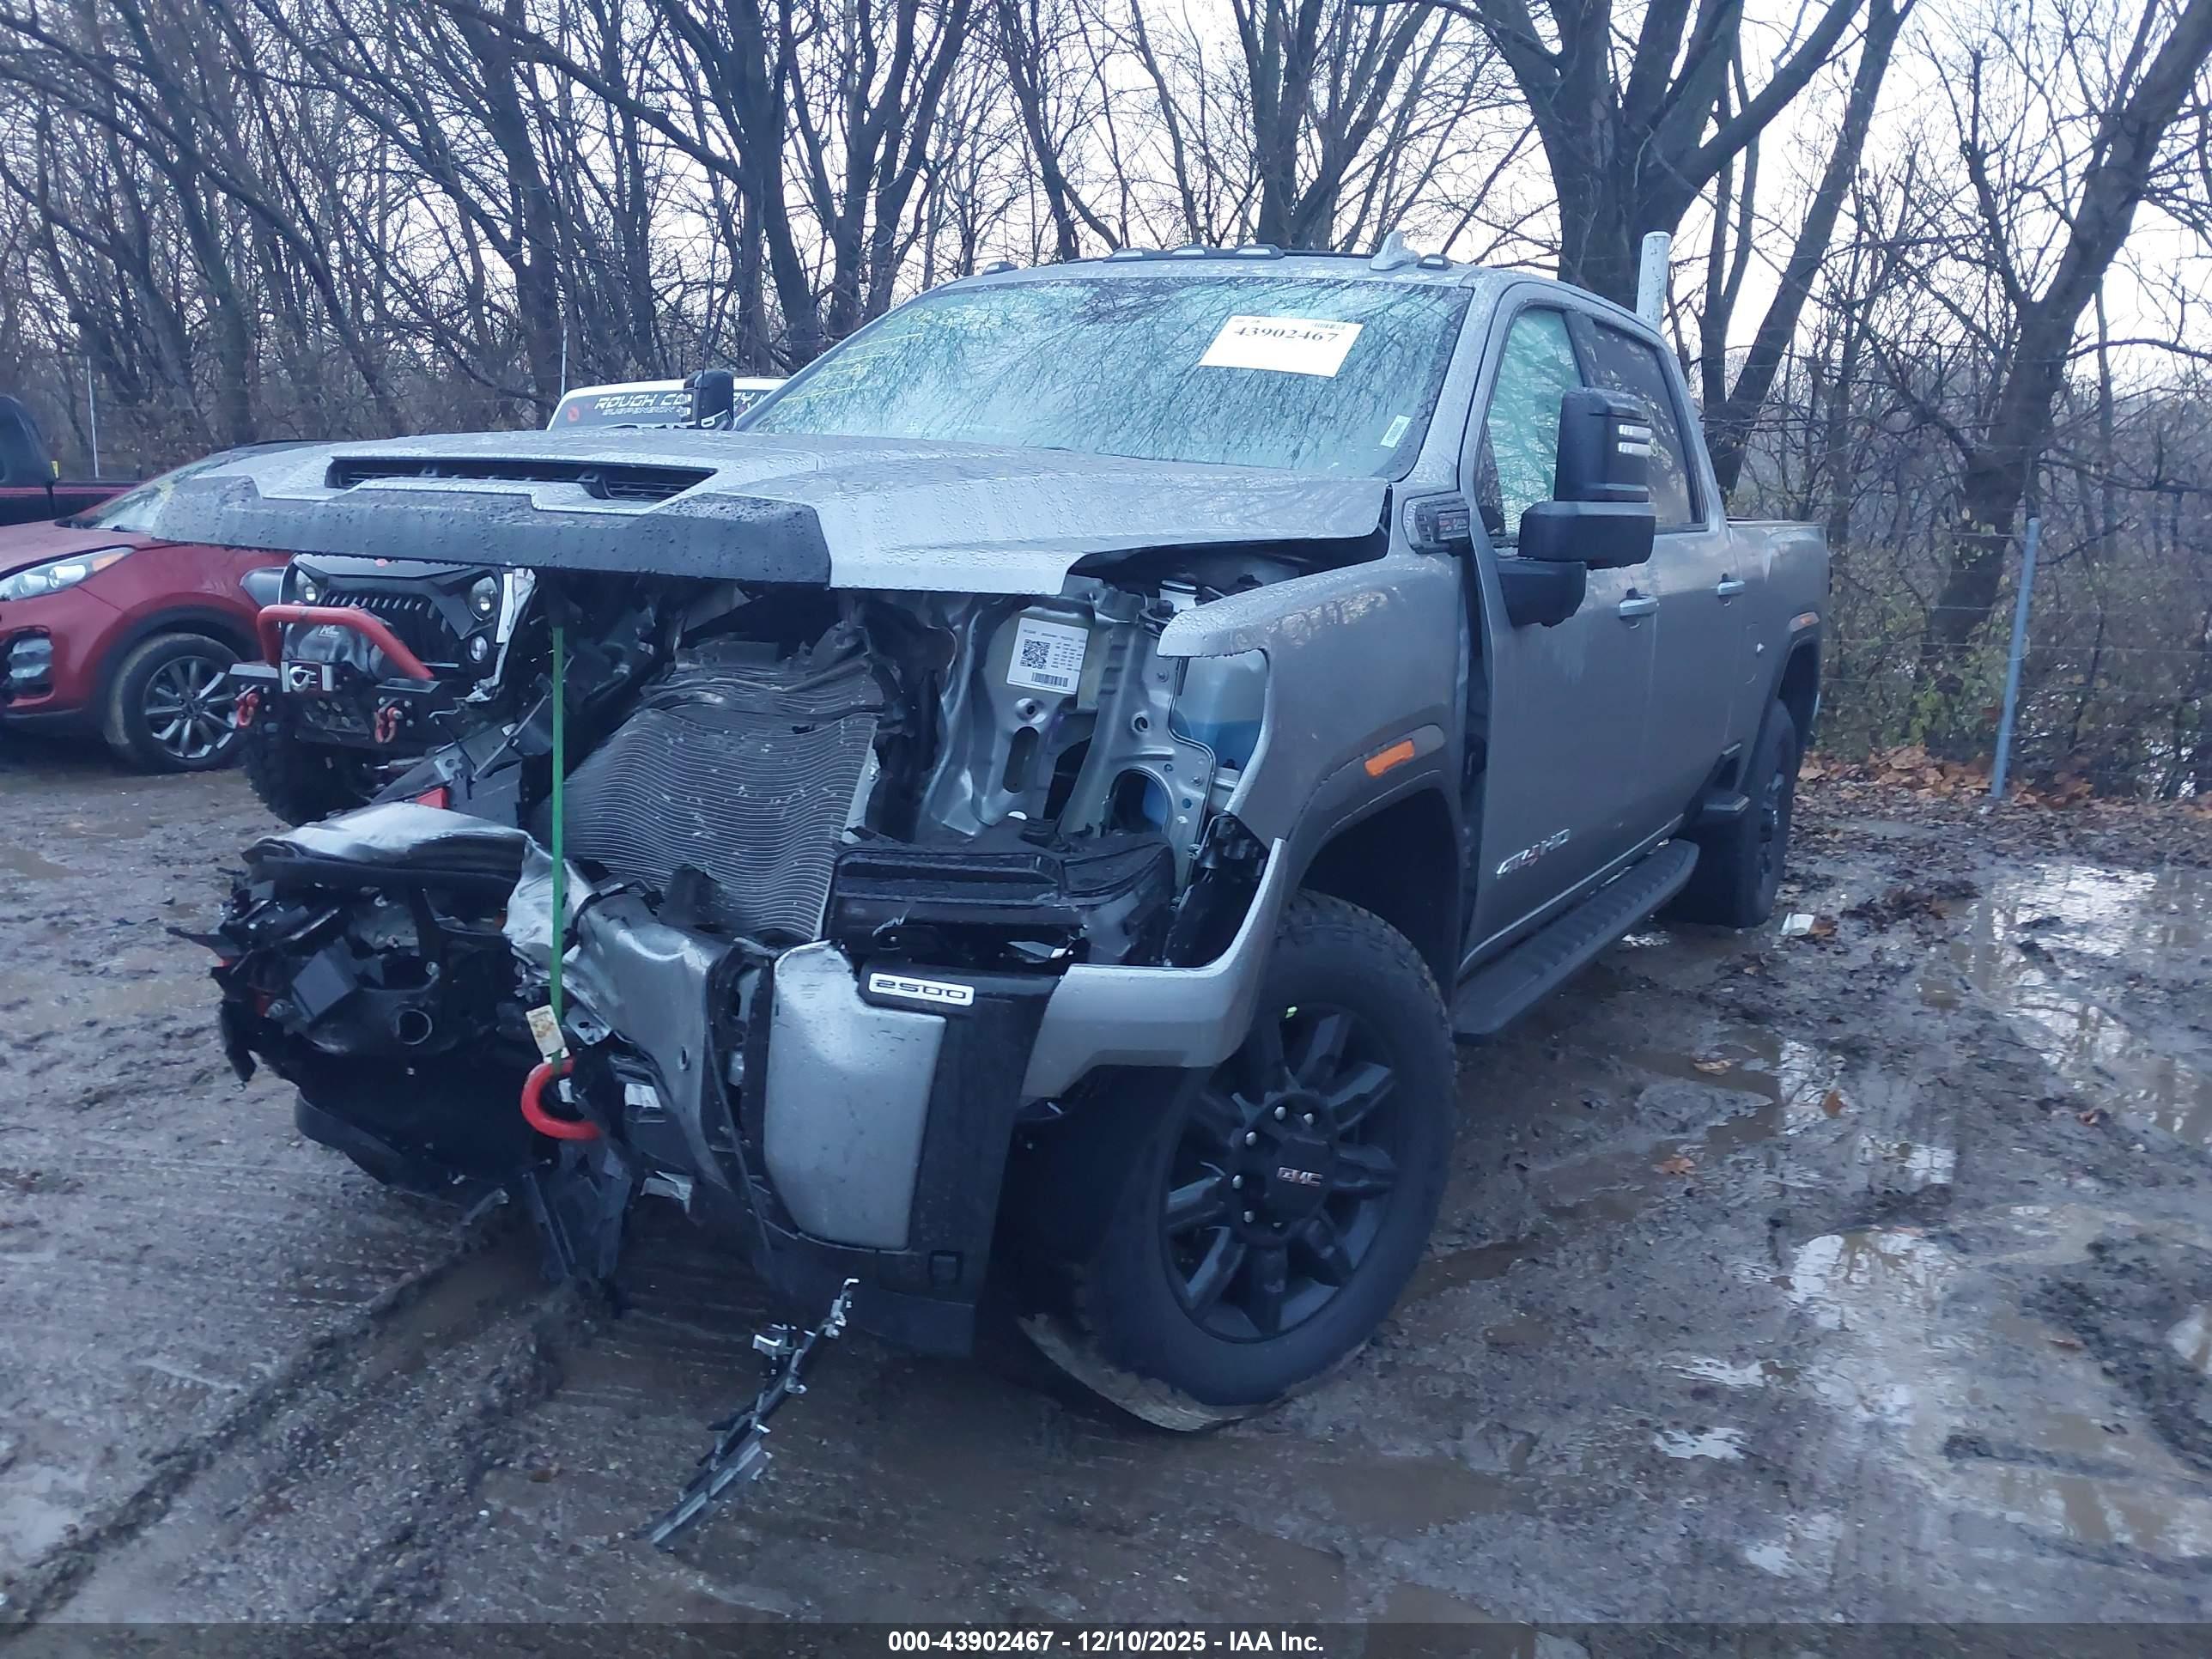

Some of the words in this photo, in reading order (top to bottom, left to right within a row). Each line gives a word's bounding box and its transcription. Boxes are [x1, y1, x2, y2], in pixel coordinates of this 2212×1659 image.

[1234, 327, 1340, 342] 43902467
[594, 394, 659, 410] ROUGH
[874, 980, 967, 999] 2500
[1276, 1167, 1323, 1186] GMC
